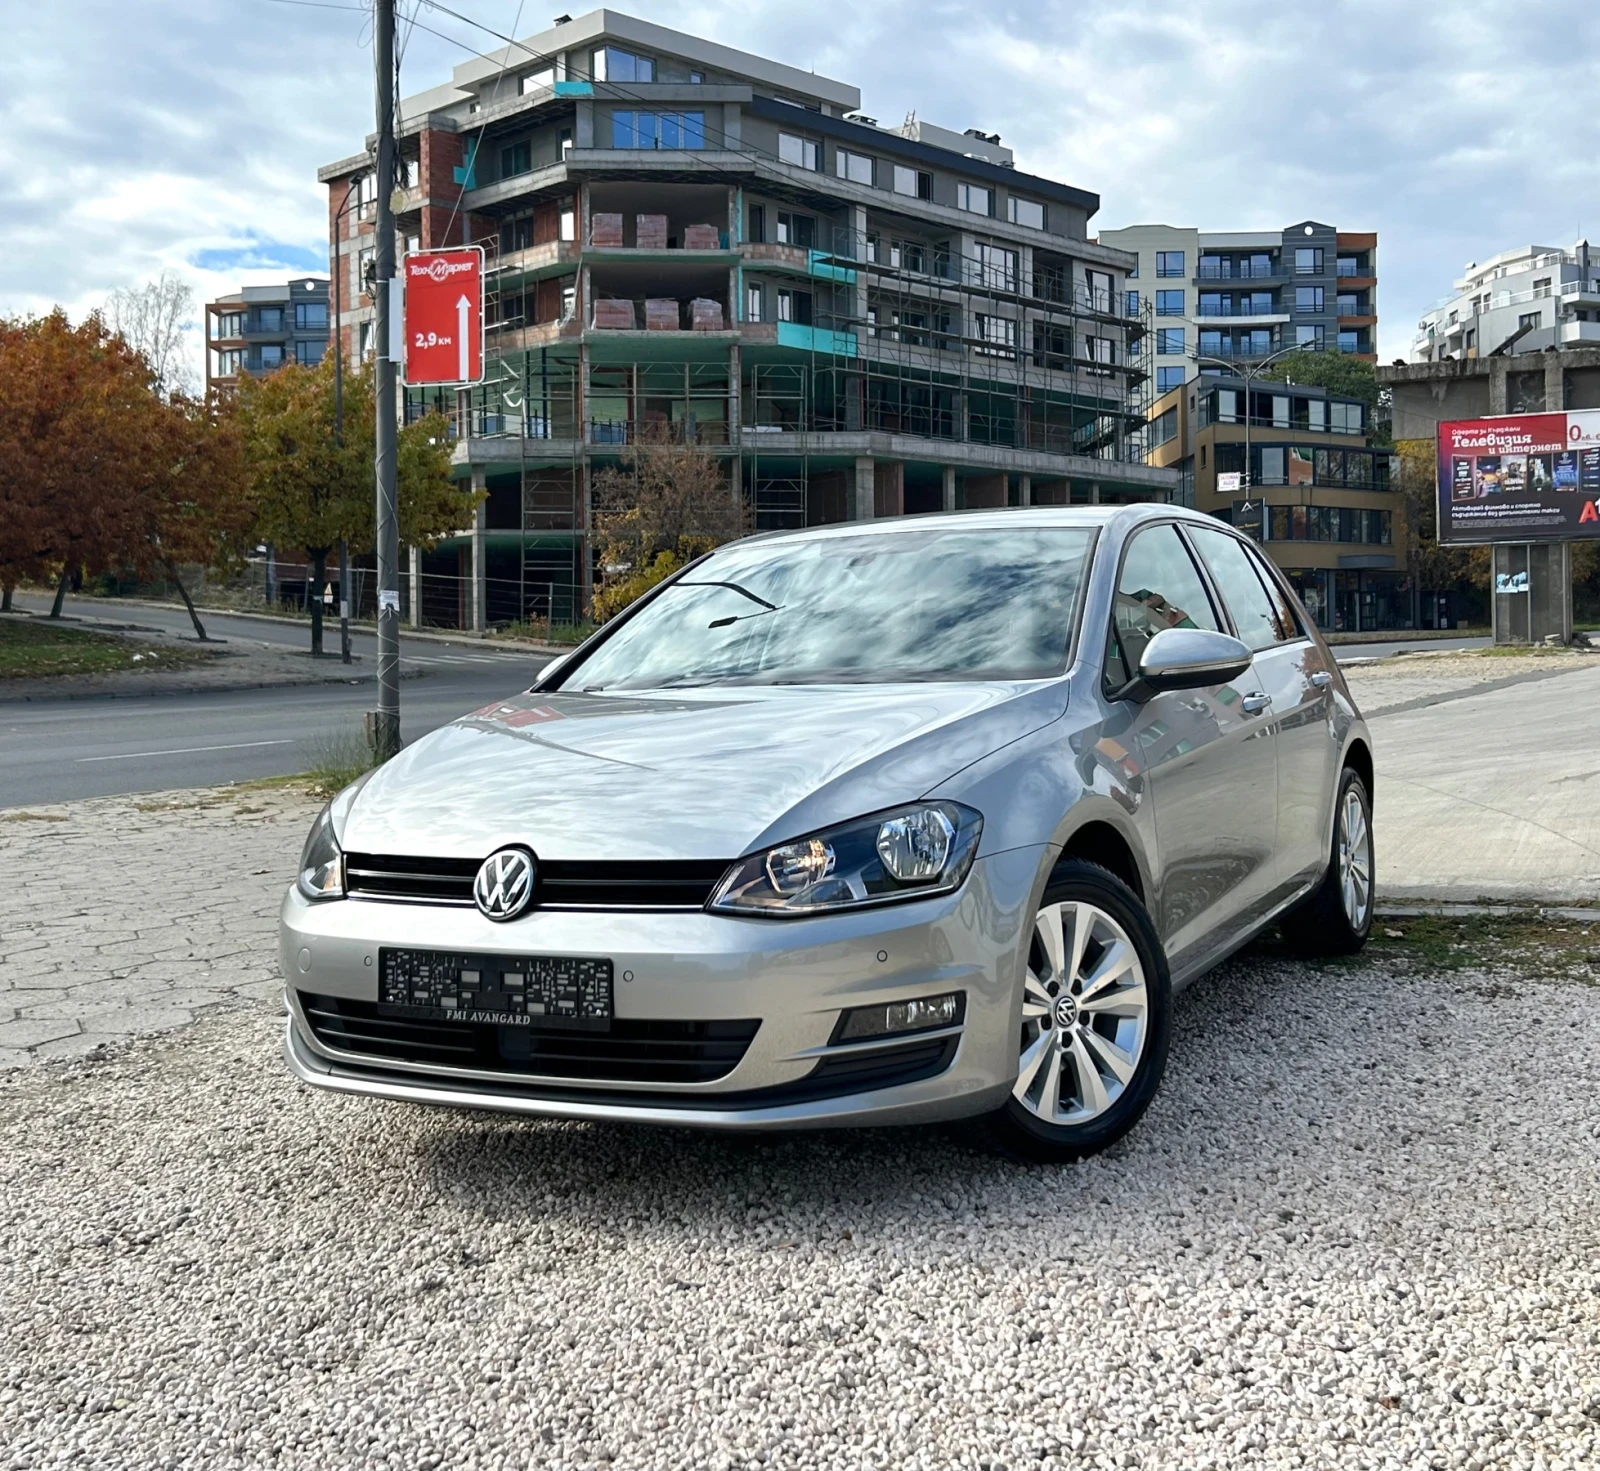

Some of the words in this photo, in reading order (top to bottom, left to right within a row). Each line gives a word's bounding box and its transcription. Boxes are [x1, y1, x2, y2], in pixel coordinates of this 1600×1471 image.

[415, 332, 437, 349] 2,9
[1452, 433, 1532, 447] Телевизия
[1499, 443, 1562, 454] интернет
[446, 1010, 467, 1020] FMI
[470, 1012, 531, 1025] AVANGARD
